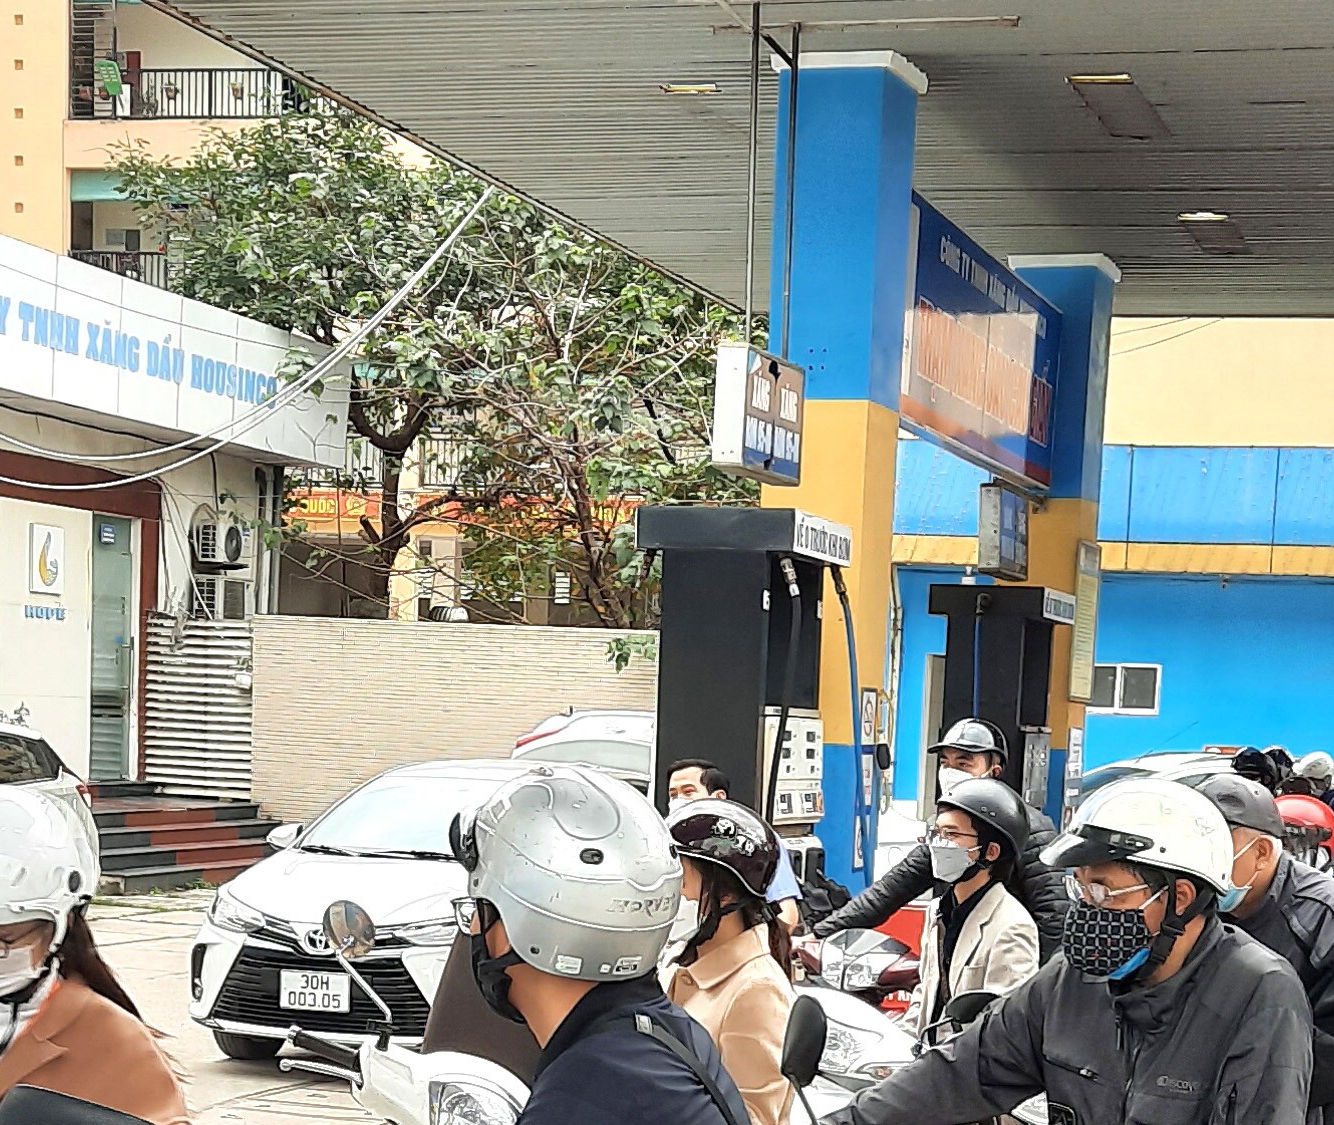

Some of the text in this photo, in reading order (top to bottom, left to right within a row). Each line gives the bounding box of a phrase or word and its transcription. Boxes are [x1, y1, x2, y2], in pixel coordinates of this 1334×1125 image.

[19, 301, 80, 355] TNHH
[85, 320, 140, 372] XĂNG
[147, 334, 185, 385] DẦU
[300, 974, 329, 990] 30H
[288, 991, 341, 1009] 003.05
